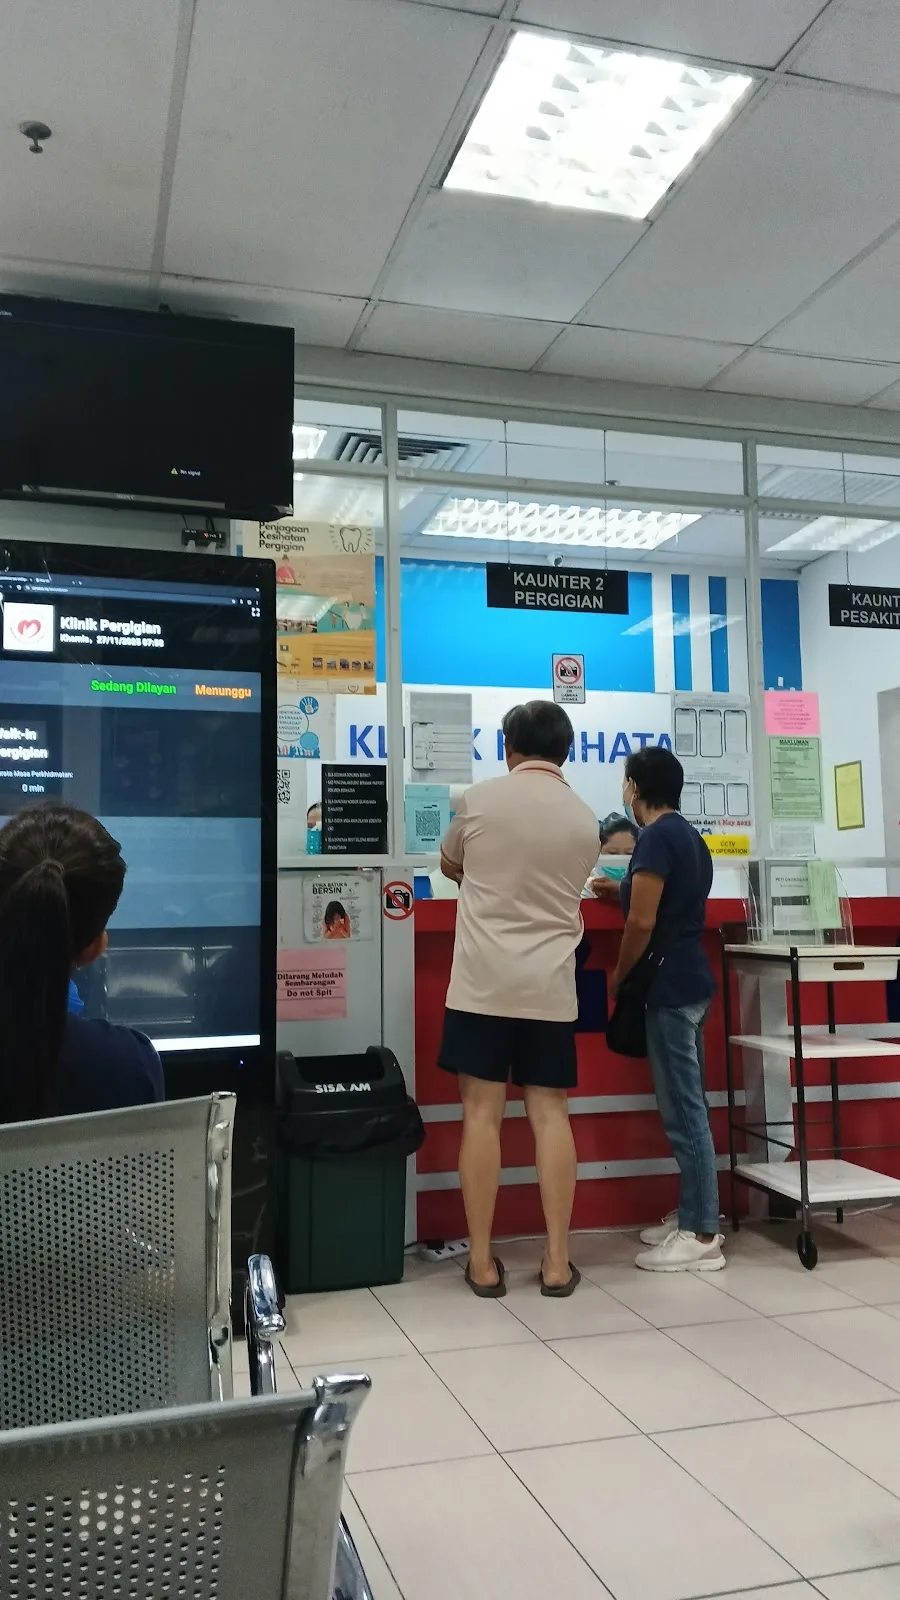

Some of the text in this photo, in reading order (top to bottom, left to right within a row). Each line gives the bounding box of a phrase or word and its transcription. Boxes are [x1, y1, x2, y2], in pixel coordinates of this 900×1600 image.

[259, 520, 309, 533] Penjagaan
[259, 530, 306, 542] Kesihatan
[259, 540, 304, 552] Pergigian
[513, 571, 604, 590] KAUNTER 2
[514, 591, 604, 609] PERGIGIAN
[852, 592, 900, 608] KAUNT
[841, 609, 900, 625] PESAKIT
[60, 616, 161, 636] Klinik Pergigian
[91, 680, 176, 695] Sedang Dilayan
[195, 684, 251, 699] Menunggu
[0, 746, 48, 761] ergigian
[22, 783, 45, 793] 0 min
[312, 887, 342, 895] BERSIN
[277, 971, 343, 981] Dilarang Meludah
[284, 979, 336, 987] Sembarangan
[286, 989, 298, 997] Do
[316, 988, 332, 997] Spit
[315, 1083, 346, 1093] SISA
